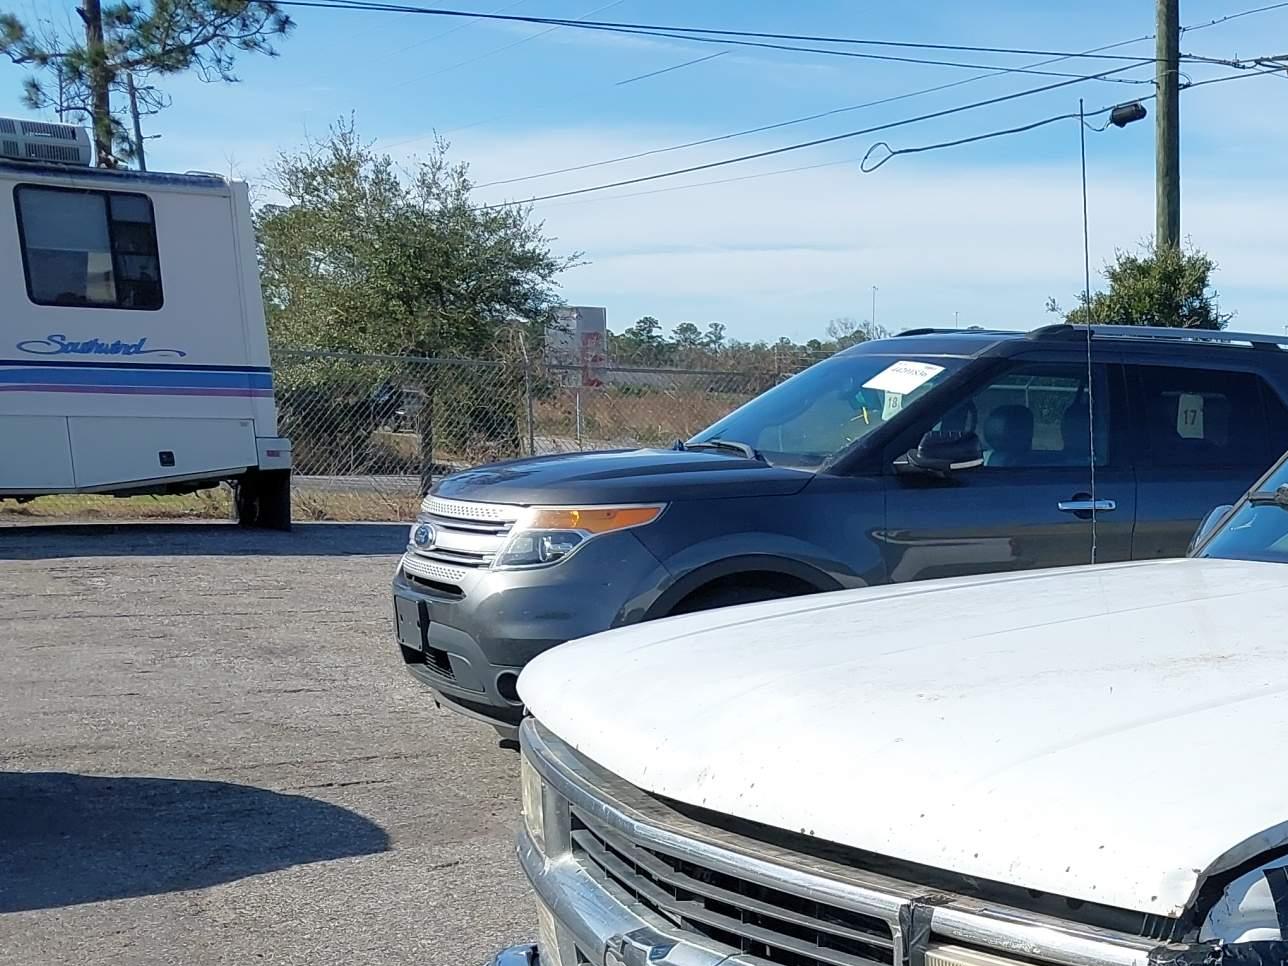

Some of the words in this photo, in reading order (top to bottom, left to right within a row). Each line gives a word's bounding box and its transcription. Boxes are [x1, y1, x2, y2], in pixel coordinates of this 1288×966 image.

[16, 334, 187, 357] Southwind
[888, 397, 898, 408] 18
[1184, 409, 1197, 425] 17
